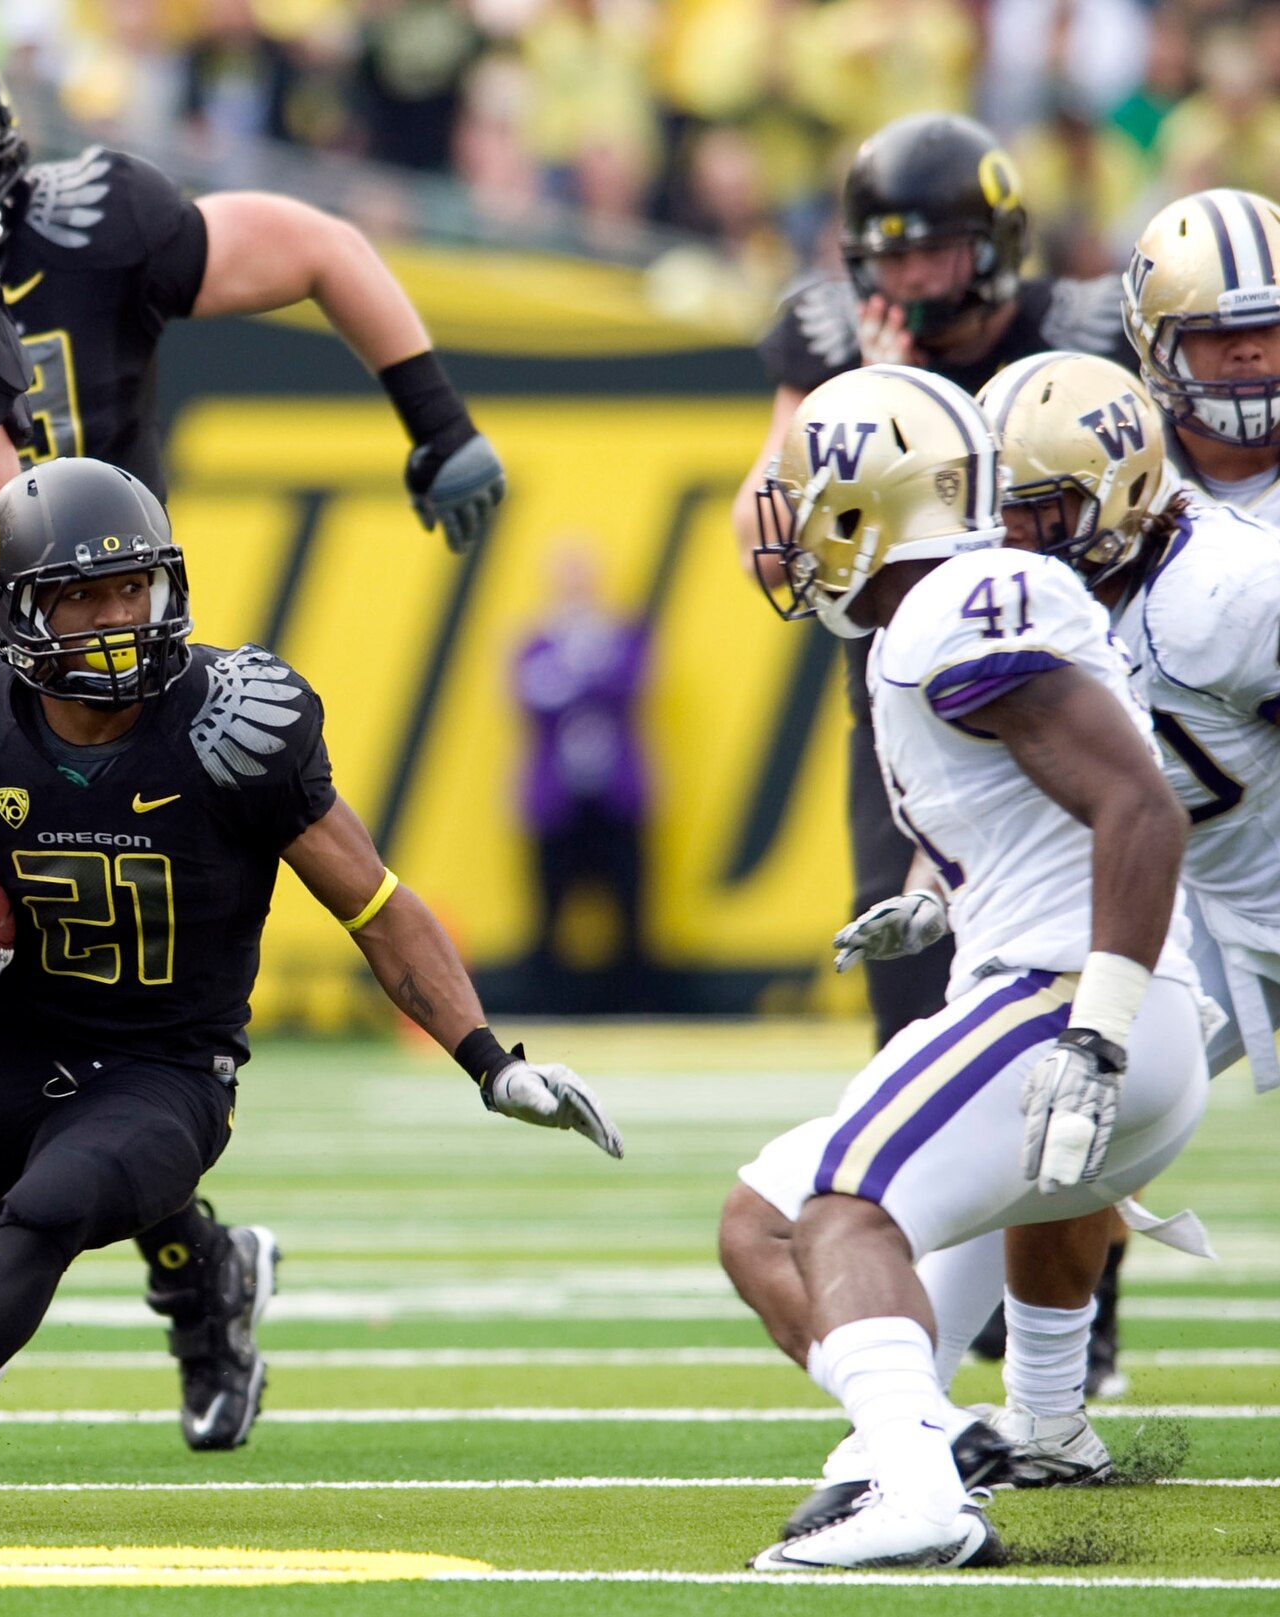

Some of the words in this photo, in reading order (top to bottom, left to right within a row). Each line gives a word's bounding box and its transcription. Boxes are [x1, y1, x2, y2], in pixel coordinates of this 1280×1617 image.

[805, 421, 877, 483] W
[1080, 393, 1146, 462] W
[102, 536, 121, 552] O
[961, 571, 1034, 640] 41
[37, 831, 152, 849] OREGON
[12, 850, 175, 986] 21
[157, 1242, 190, 1270] O
